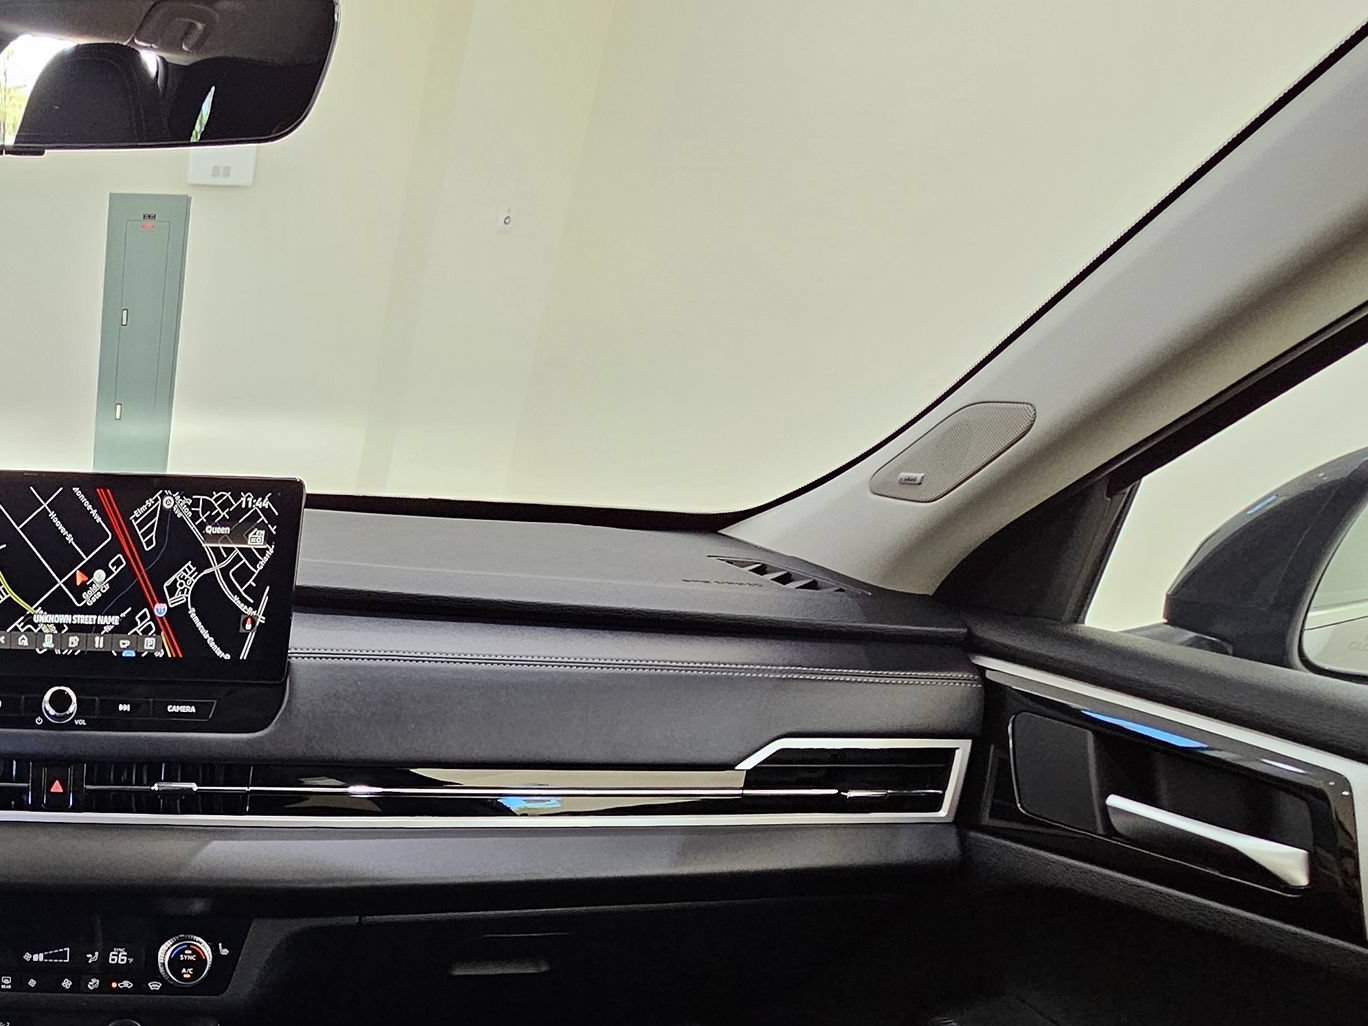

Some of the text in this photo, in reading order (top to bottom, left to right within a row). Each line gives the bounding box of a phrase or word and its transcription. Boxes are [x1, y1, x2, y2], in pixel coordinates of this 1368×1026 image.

[133, 498, 155, 518] Elm St
[241, 497, 269, 509] 11:44
[48, 510, 68, 536] Hoover
[205, 525, 231, 535] Queen
[33, 614, 120, 626] UNKNOWN STREET NAME
[188, 607, 209, 640] Temecula
[167, 705, 196, 713] CAMERA
